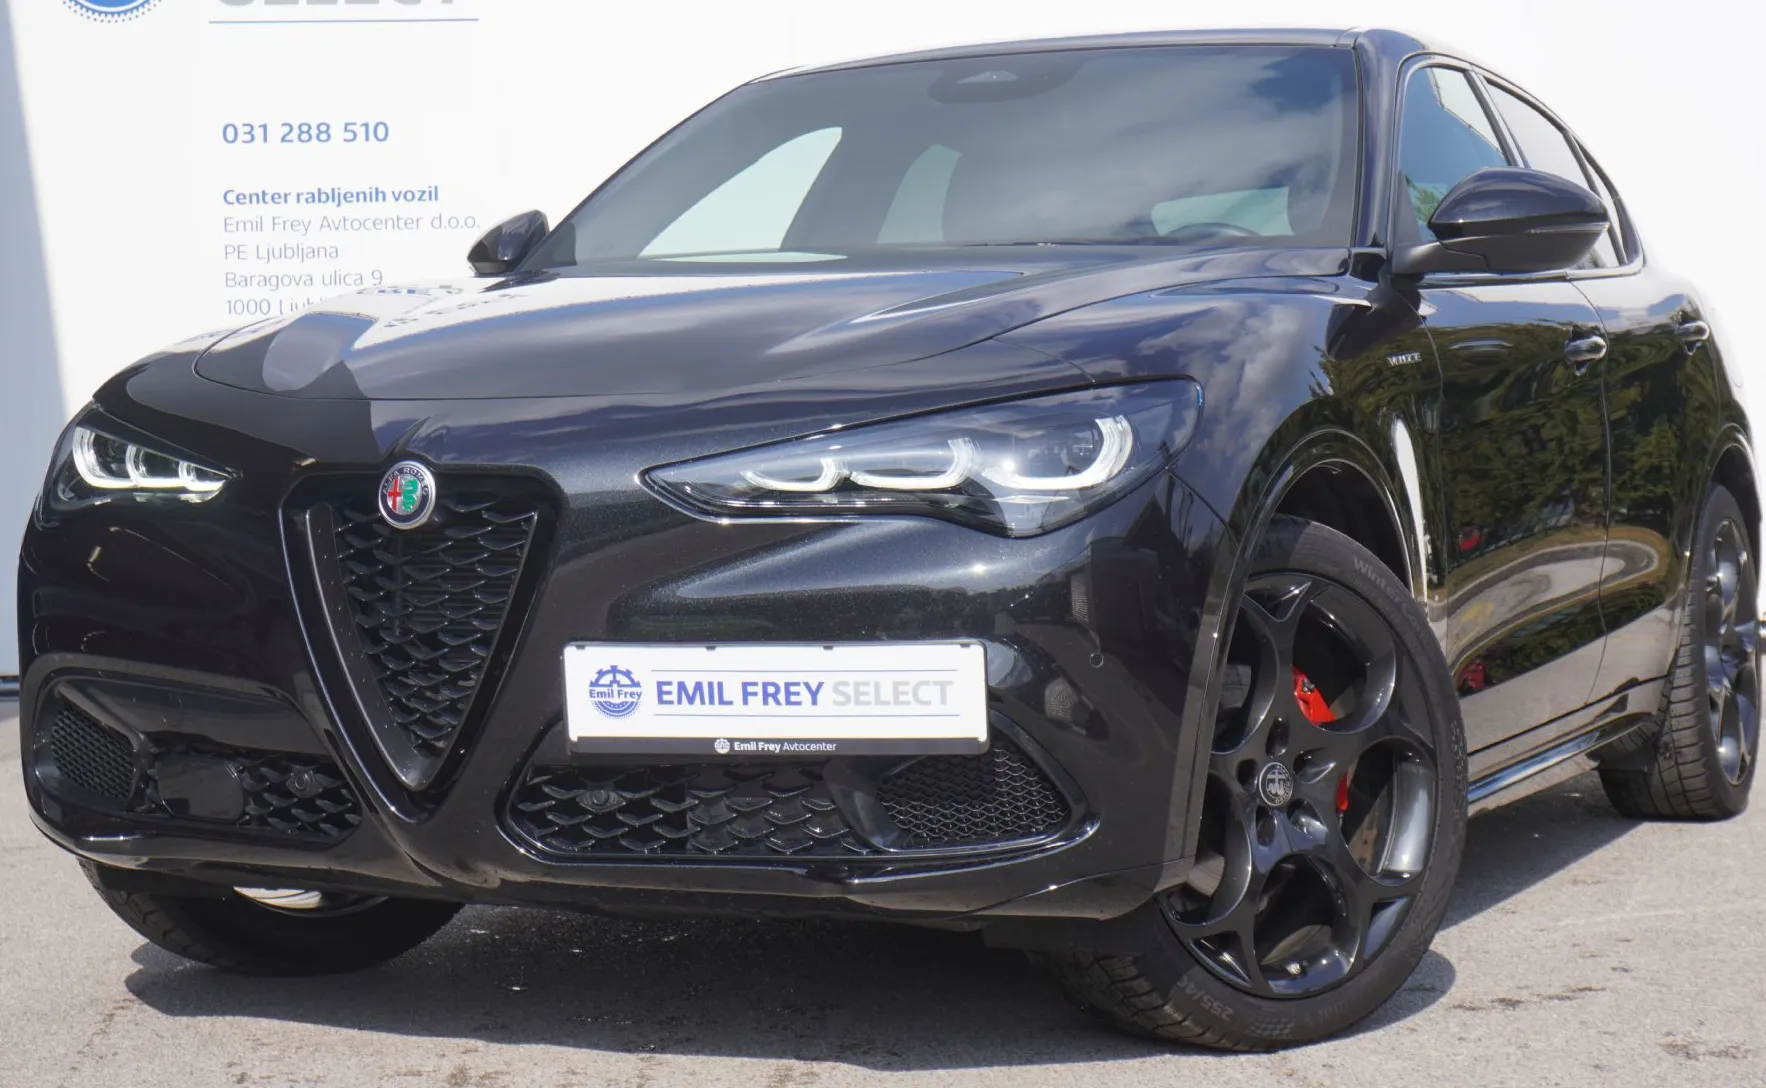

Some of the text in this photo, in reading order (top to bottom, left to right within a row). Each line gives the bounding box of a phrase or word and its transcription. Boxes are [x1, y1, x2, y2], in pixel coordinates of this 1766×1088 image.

[222, 121, 390, 144] 031 288 510
[223, 185, 439, 208] Center rabljenih vozil
[224, 212, 480, 236] Emil Frey Avtocenter d.o.o.
[224, 242, 339, 264] PE Ljubljana
[225, 269, 384, 292] Baragova ulica 9
[226, 299, 271, 315] 1000
[589, 688, 643, 701] Emil Frey
[656, 680, 954, 707] EMIL FREY SELECT
[734, 741, 757, 751] Emil
[758, 742, 781, 753] Frey
[782, 741, 837, 752] Avtocenter
